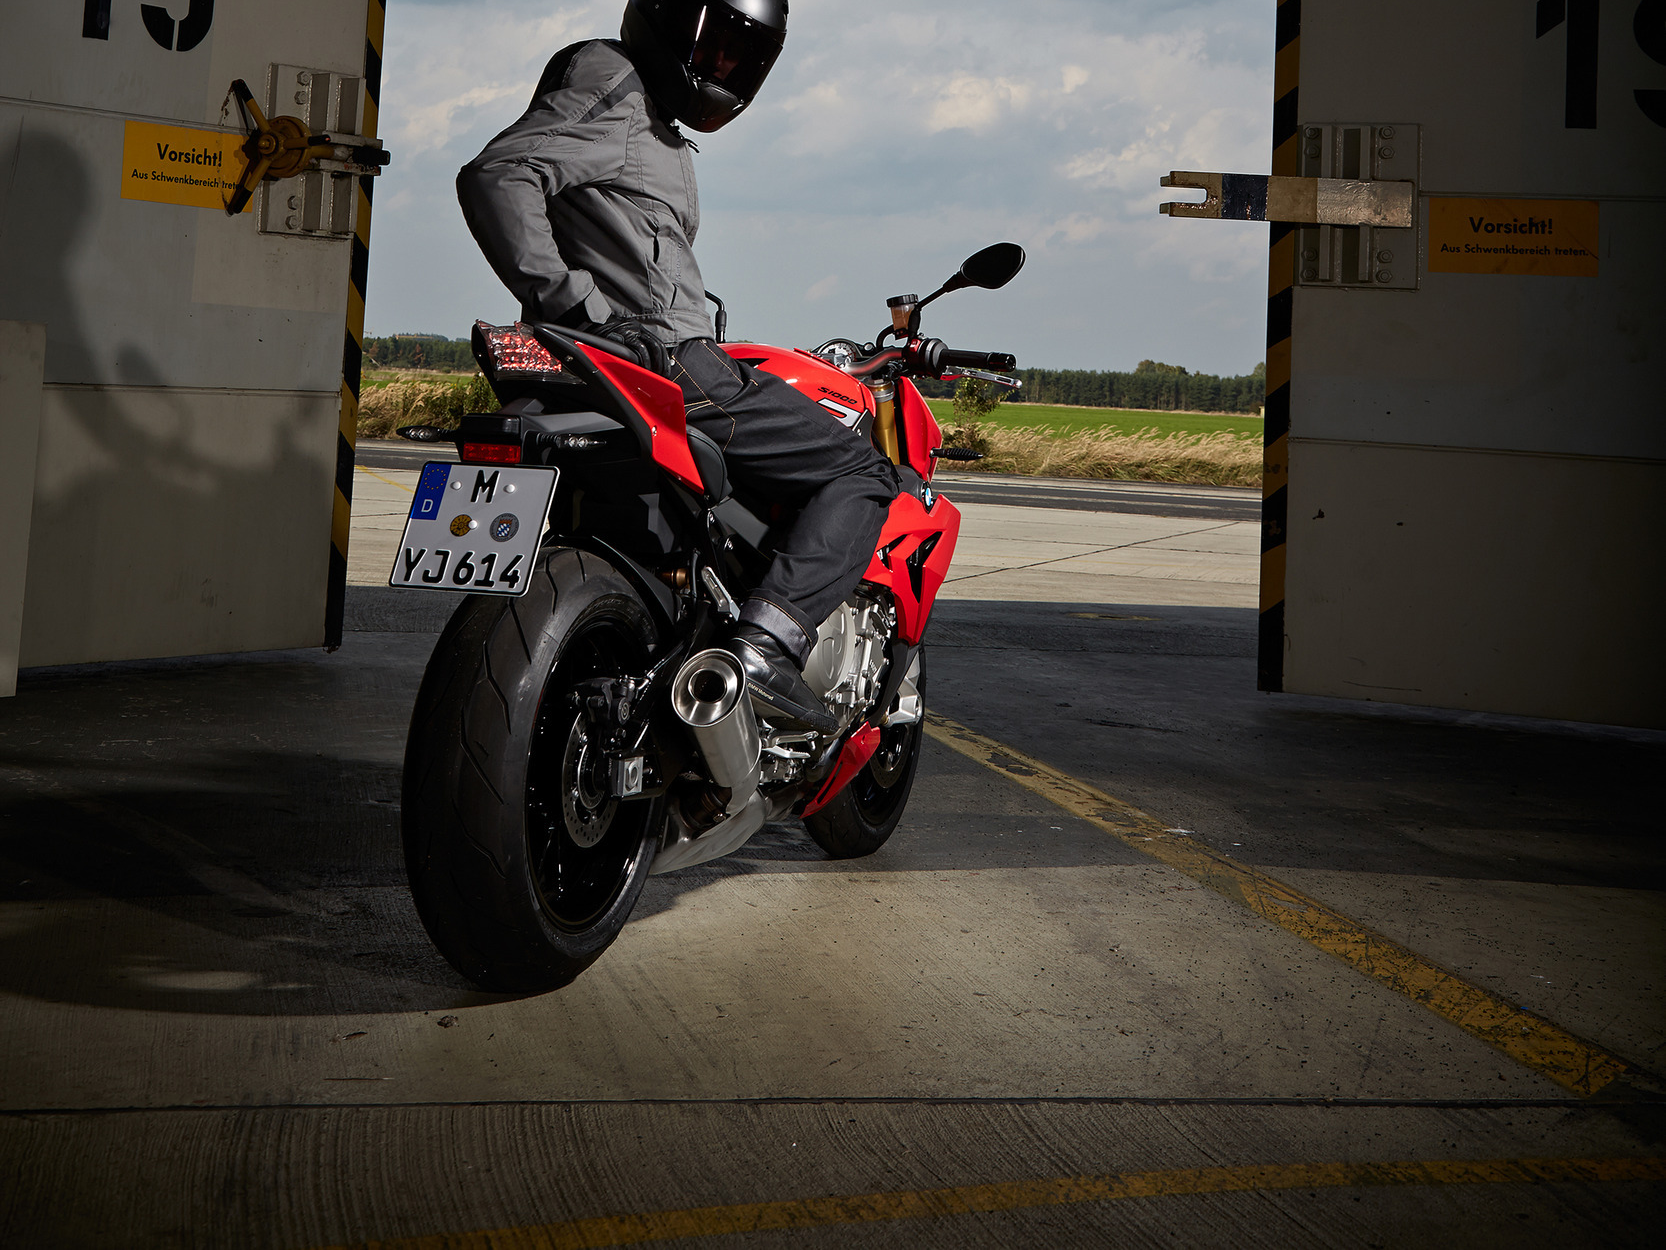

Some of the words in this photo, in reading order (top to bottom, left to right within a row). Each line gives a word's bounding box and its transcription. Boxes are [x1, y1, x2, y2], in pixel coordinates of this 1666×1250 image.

[157, 142, 222, 167] Vorsicht!
[131, 168, 148, 180] Aus
[151, 170, 219, 189] Schwenkbereich
[1469, 216, 1553, 235] Vorsicht!
[1440, 243, 1461, 253] Aus
[1464, 243, 1551, 256] Schwenkbereich
[1555, 247, 1589, 257] treten.
[817, 386, 858, 405] S1000
[470, 469, 500, 503] M
[420, 498, 434, 513] D
